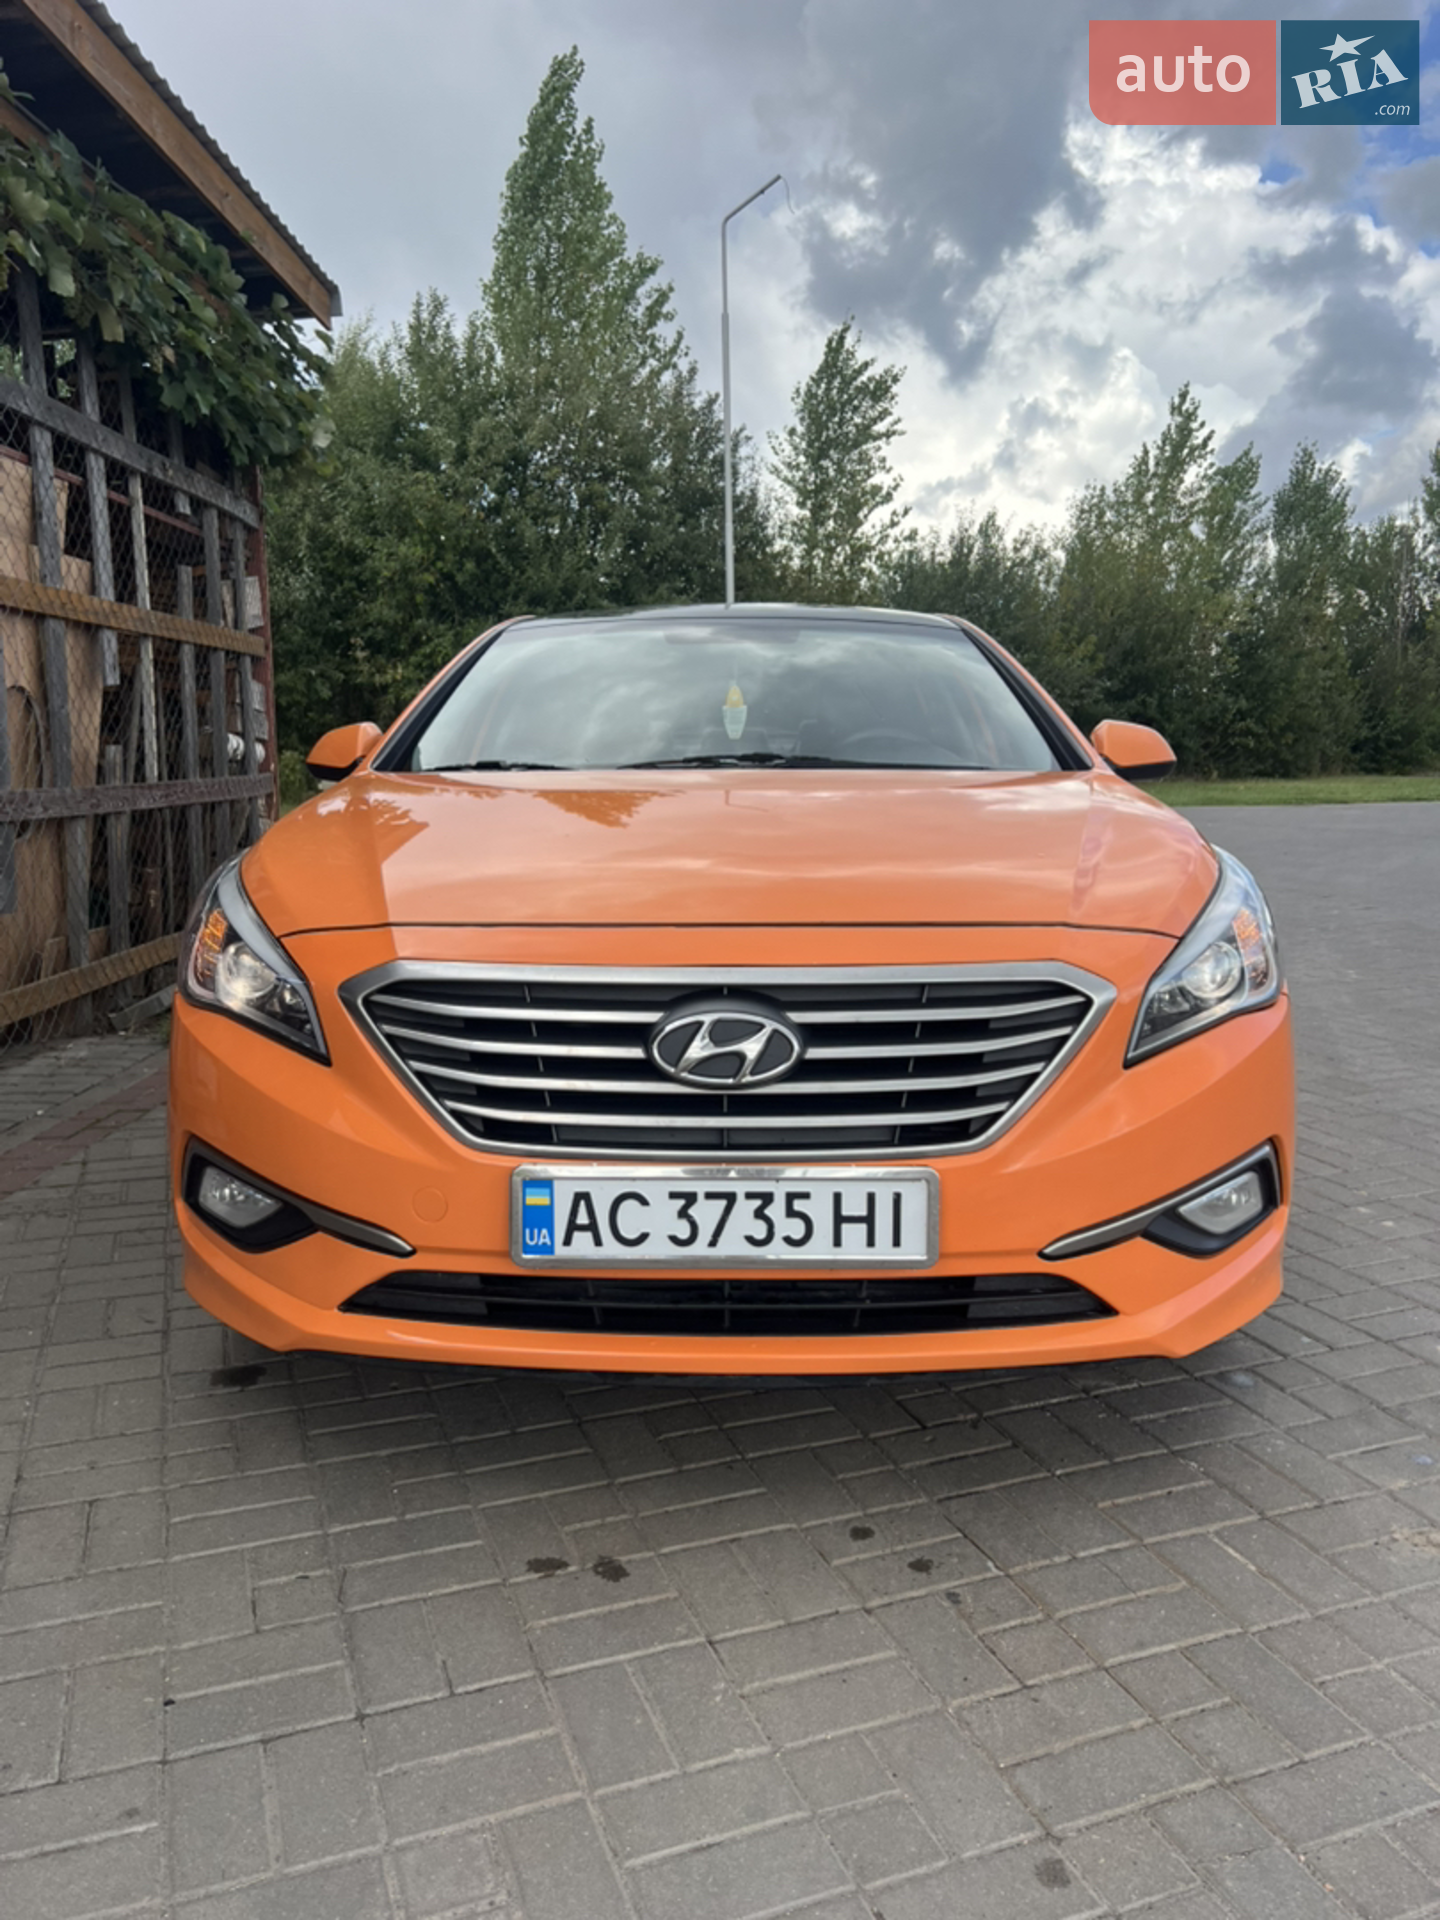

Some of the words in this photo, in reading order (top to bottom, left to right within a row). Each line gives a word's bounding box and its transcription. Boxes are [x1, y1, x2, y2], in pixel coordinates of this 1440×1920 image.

[525, 1228, 551, 1247] UA
[562, 1191, 651, 1248] AC
[667, 1191, 814, 1248] 3735
[832, 1191, 903, 1248] HI
